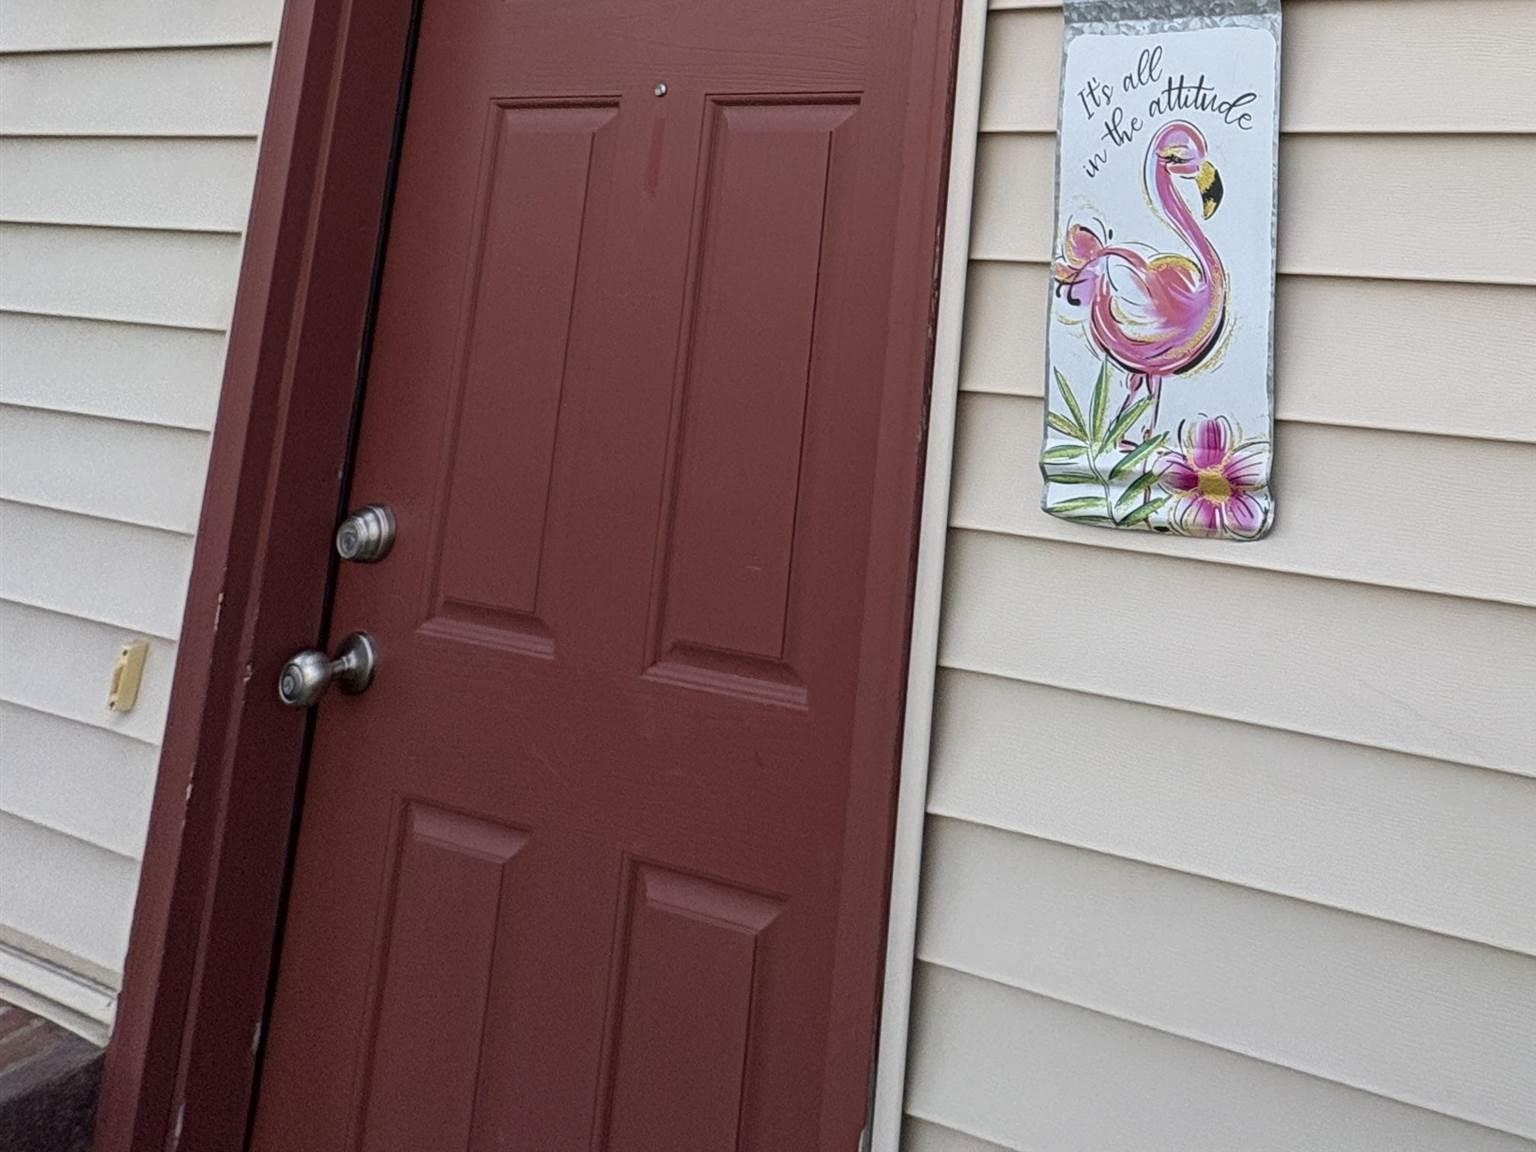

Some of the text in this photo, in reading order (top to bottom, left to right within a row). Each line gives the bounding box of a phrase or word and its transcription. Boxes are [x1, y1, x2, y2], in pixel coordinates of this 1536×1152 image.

[1078, 45, 1164, 120] It's all
[1082, 74, 1258, 179] in the attitude
